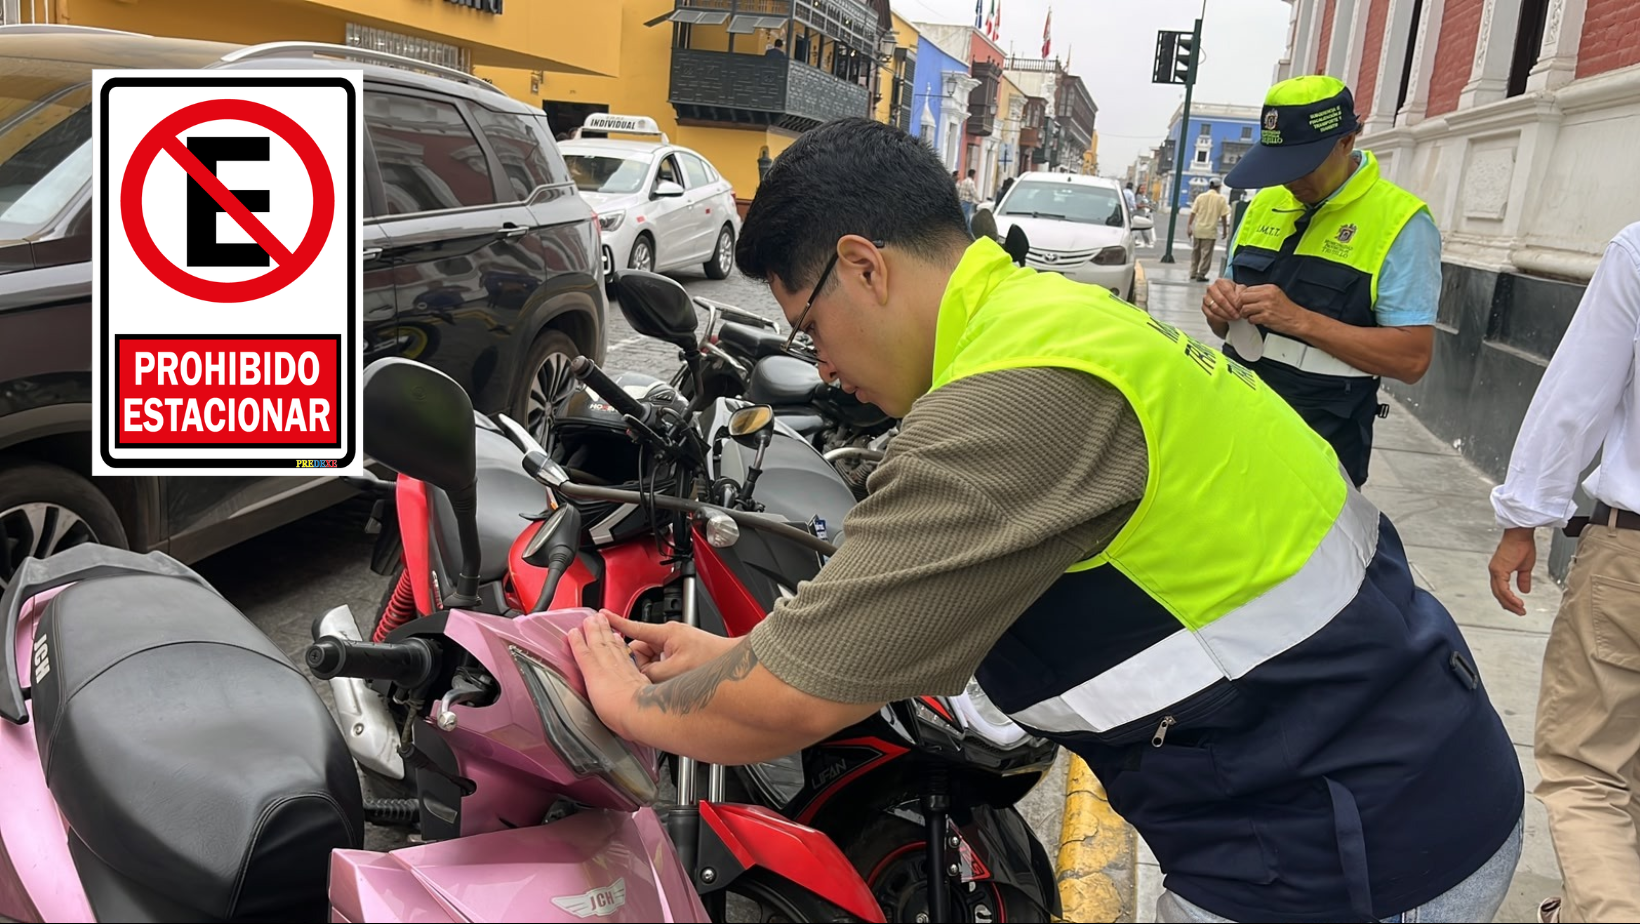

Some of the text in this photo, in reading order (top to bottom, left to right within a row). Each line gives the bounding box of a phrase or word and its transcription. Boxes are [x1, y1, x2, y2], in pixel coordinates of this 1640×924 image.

[590, 119, 636, 130] INDIVIDUAL
[34, 633, 51, 684] JCH
[811, 758, 847, 790] LIFAN
[590, 891, 615, 911] JCH
